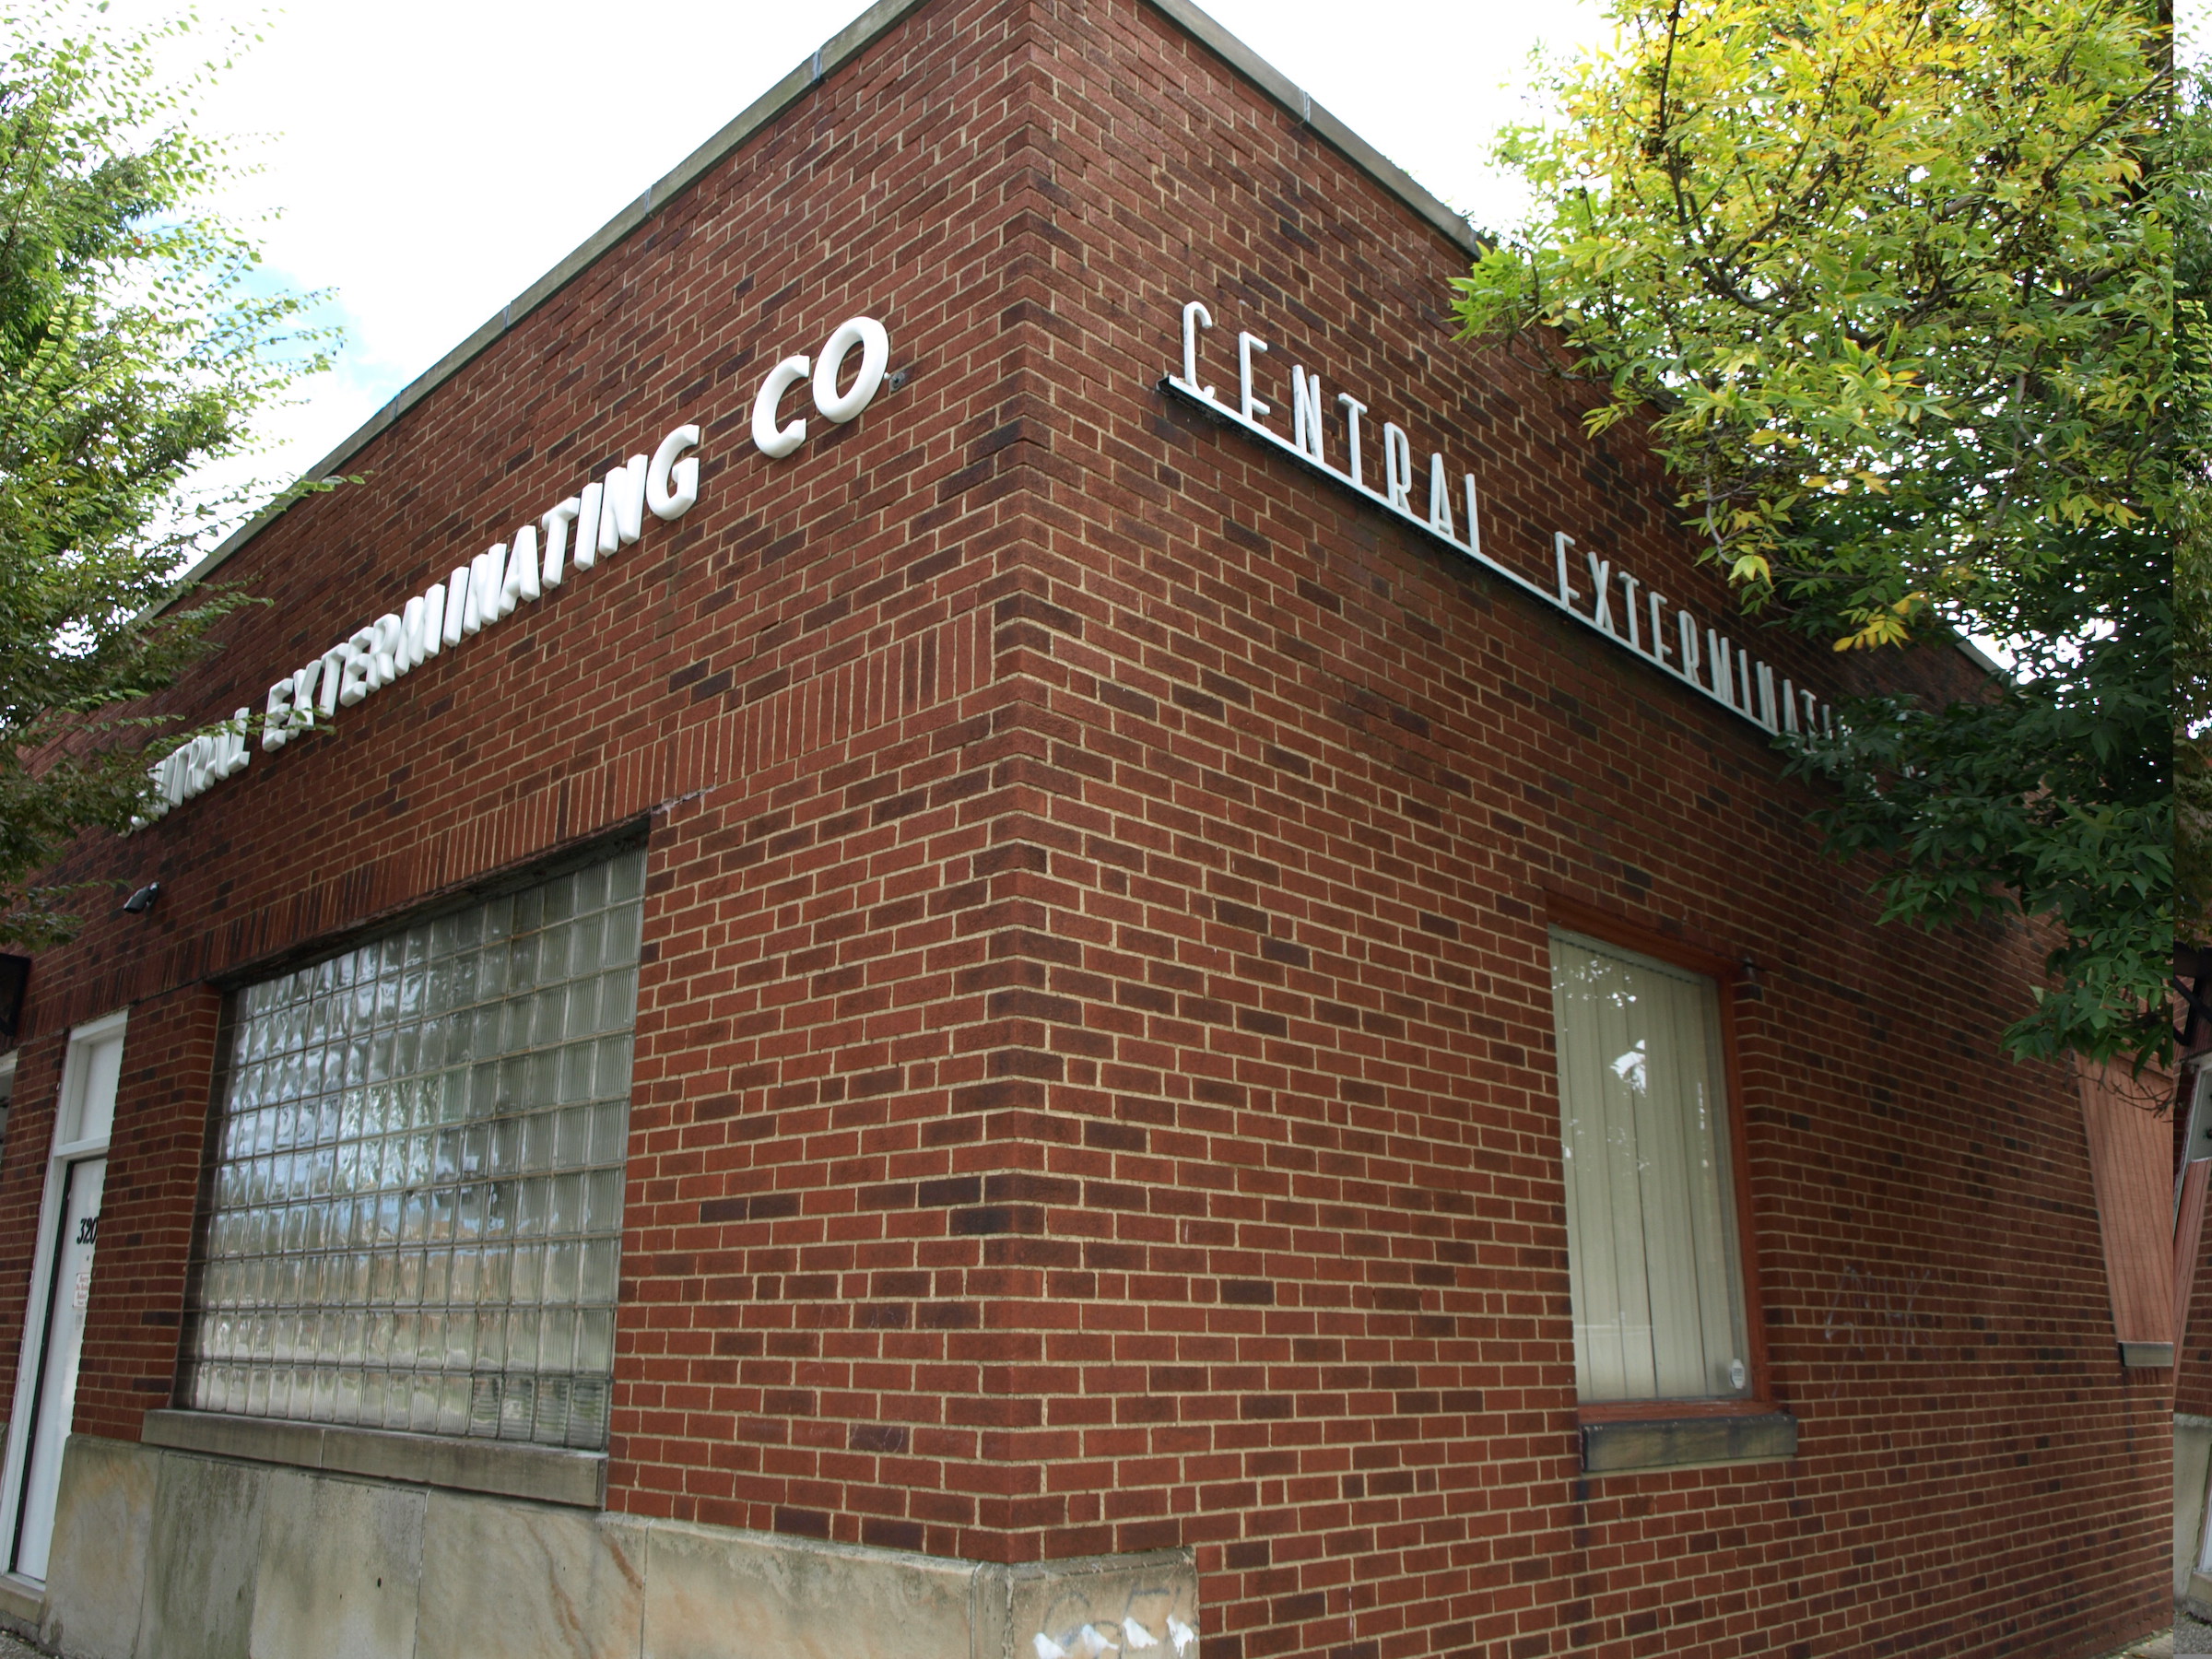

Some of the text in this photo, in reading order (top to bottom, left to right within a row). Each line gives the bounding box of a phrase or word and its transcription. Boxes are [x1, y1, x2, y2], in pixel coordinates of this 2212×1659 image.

[262, 424, 700, 753] EXTERMINATING
[751, 316, 889, 458] CO
[1182, 300, 1851, 754] CENTRAL EXTERMINATI
[76, 1218, 99, 1244] 320
